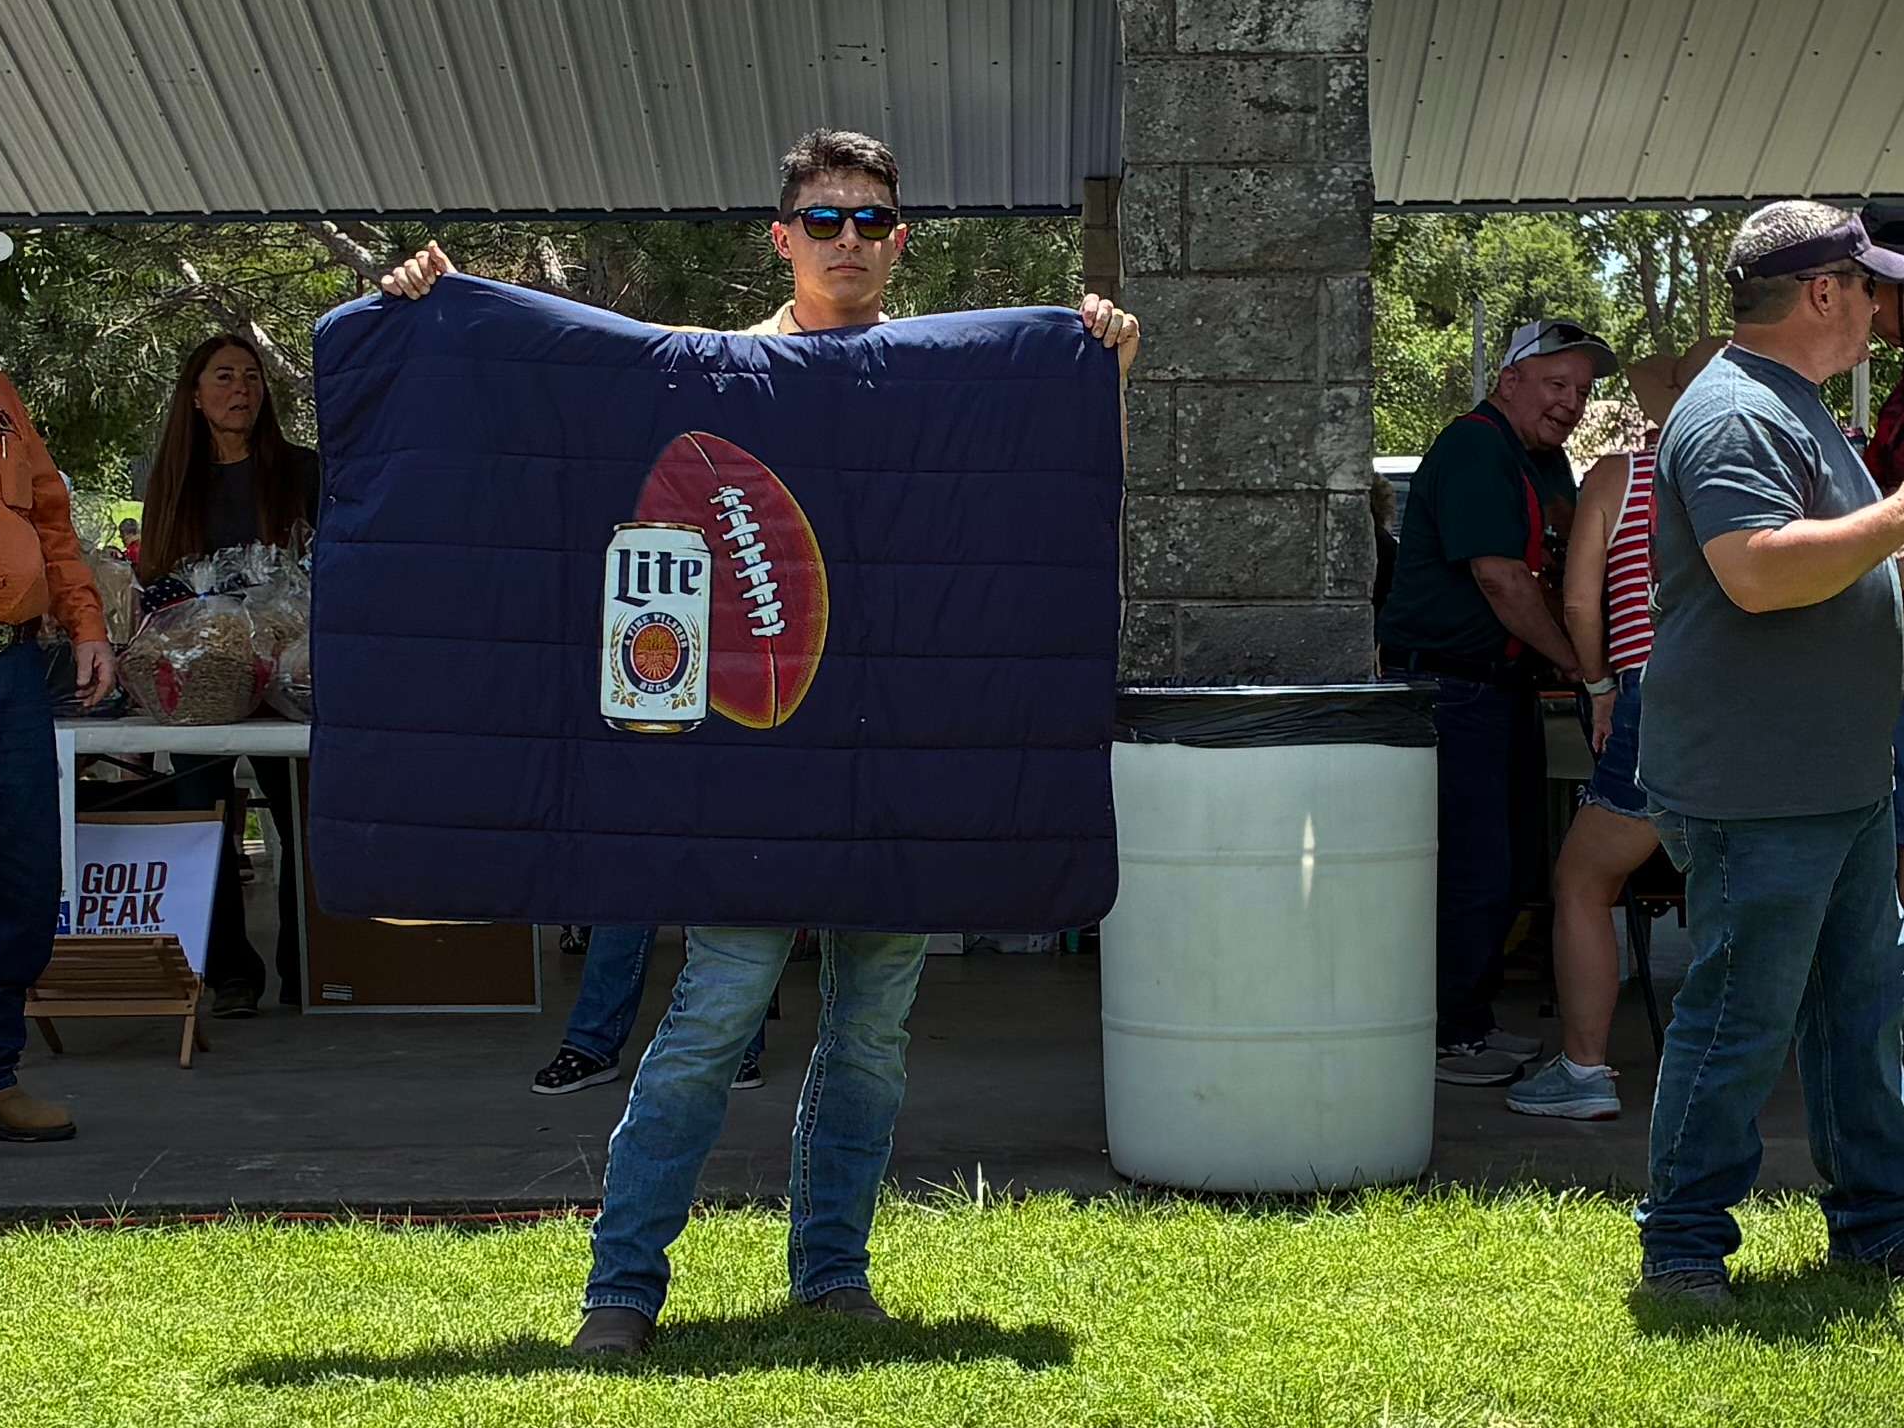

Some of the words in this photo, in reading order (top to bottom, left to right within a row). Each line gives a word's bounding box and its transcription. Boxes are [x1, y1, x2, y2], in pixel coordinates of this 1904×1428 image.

[613, 549, 702, 607] Lite
[81, 861, 168, 894] GOLD
[76, 893, 165, 927] PEAK
